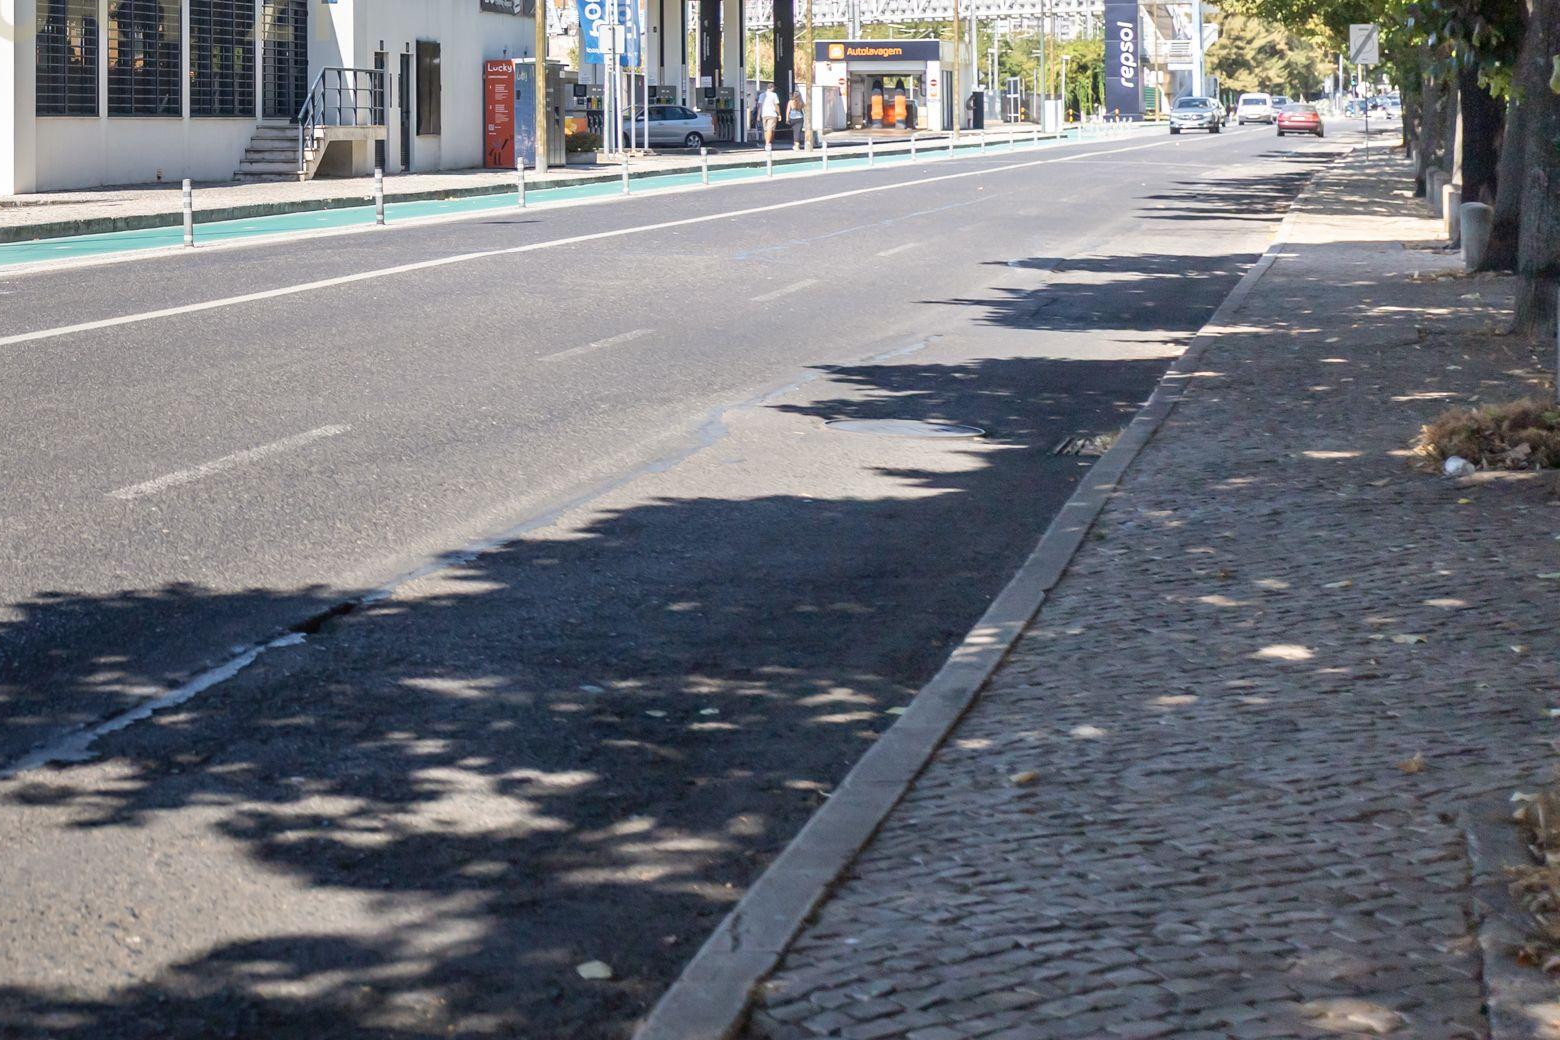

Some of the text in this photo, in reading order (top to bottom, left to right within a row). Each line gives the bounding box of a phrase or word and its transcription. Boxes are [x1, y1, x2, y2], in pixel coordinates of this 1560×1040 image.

[847, 47, 902, 57] Autolavagem
[1117, 21, 1137, 89] repsol
[487, 62, 512, 73] Lucky
